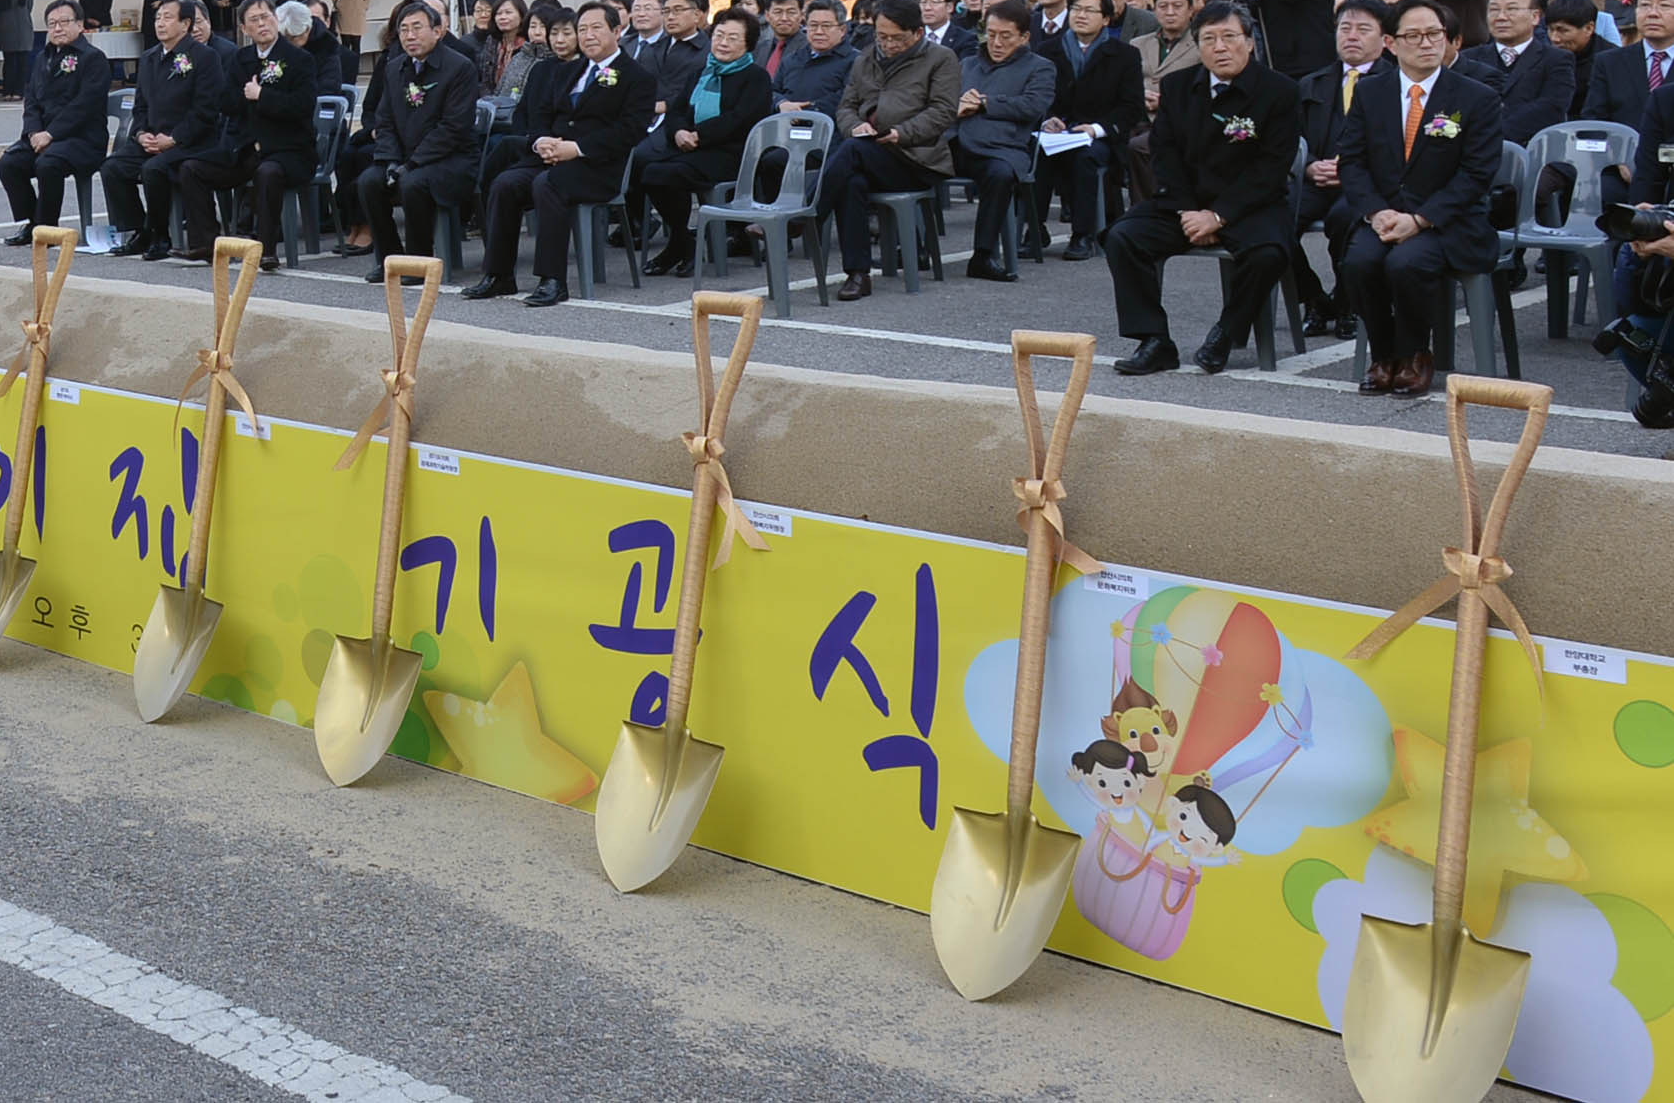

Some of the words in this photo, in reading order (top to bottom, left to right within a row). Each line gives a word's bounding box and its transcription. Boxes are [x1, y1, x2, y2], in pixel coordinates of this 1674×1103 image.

[32, 595, 92, 641] 오후
[1565, 650, 1606, 663] 한양대학교
[1574, 664, 1598, 675] 부총장
